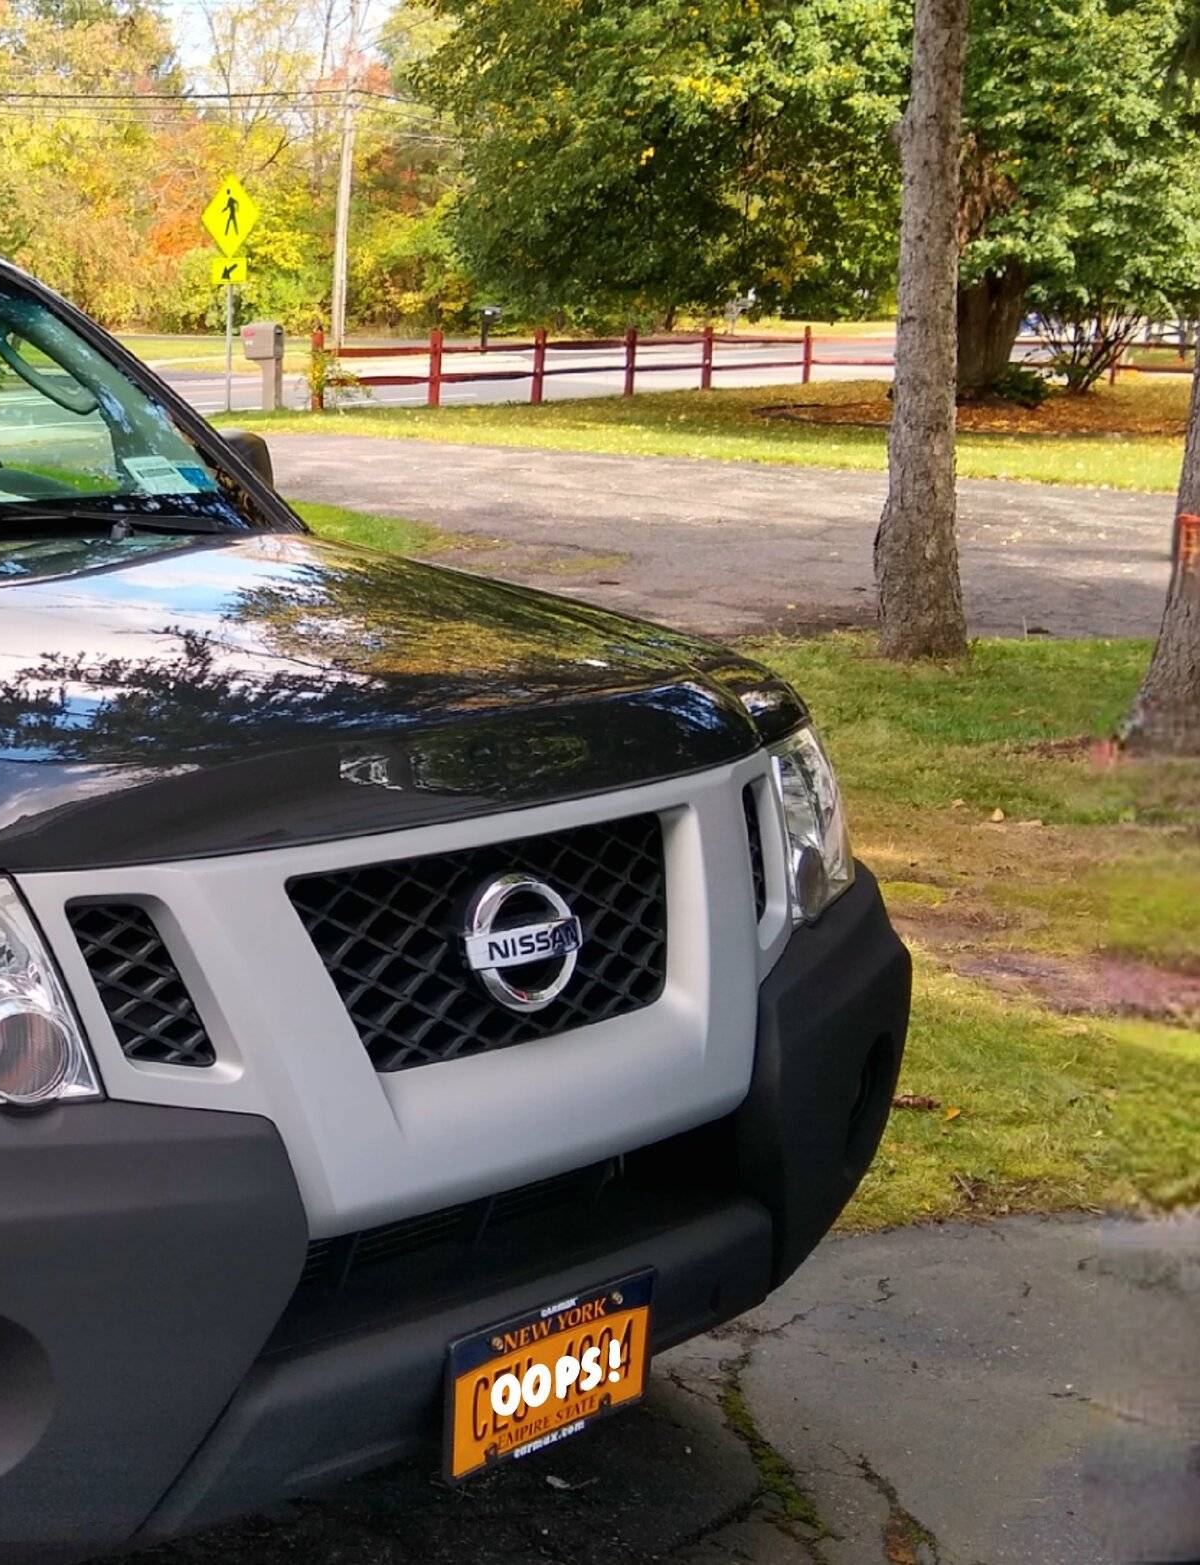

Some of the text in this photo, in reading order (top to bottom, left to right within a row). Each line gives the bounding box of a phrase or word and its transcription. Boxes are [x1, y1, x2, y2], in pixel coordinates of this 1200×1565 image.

[488, 926, 578, 960] NISSAN
[504, 1298, 606, 1353] NEW YORK
[497, 1394, 597, 1448] EMPIRE STATE
